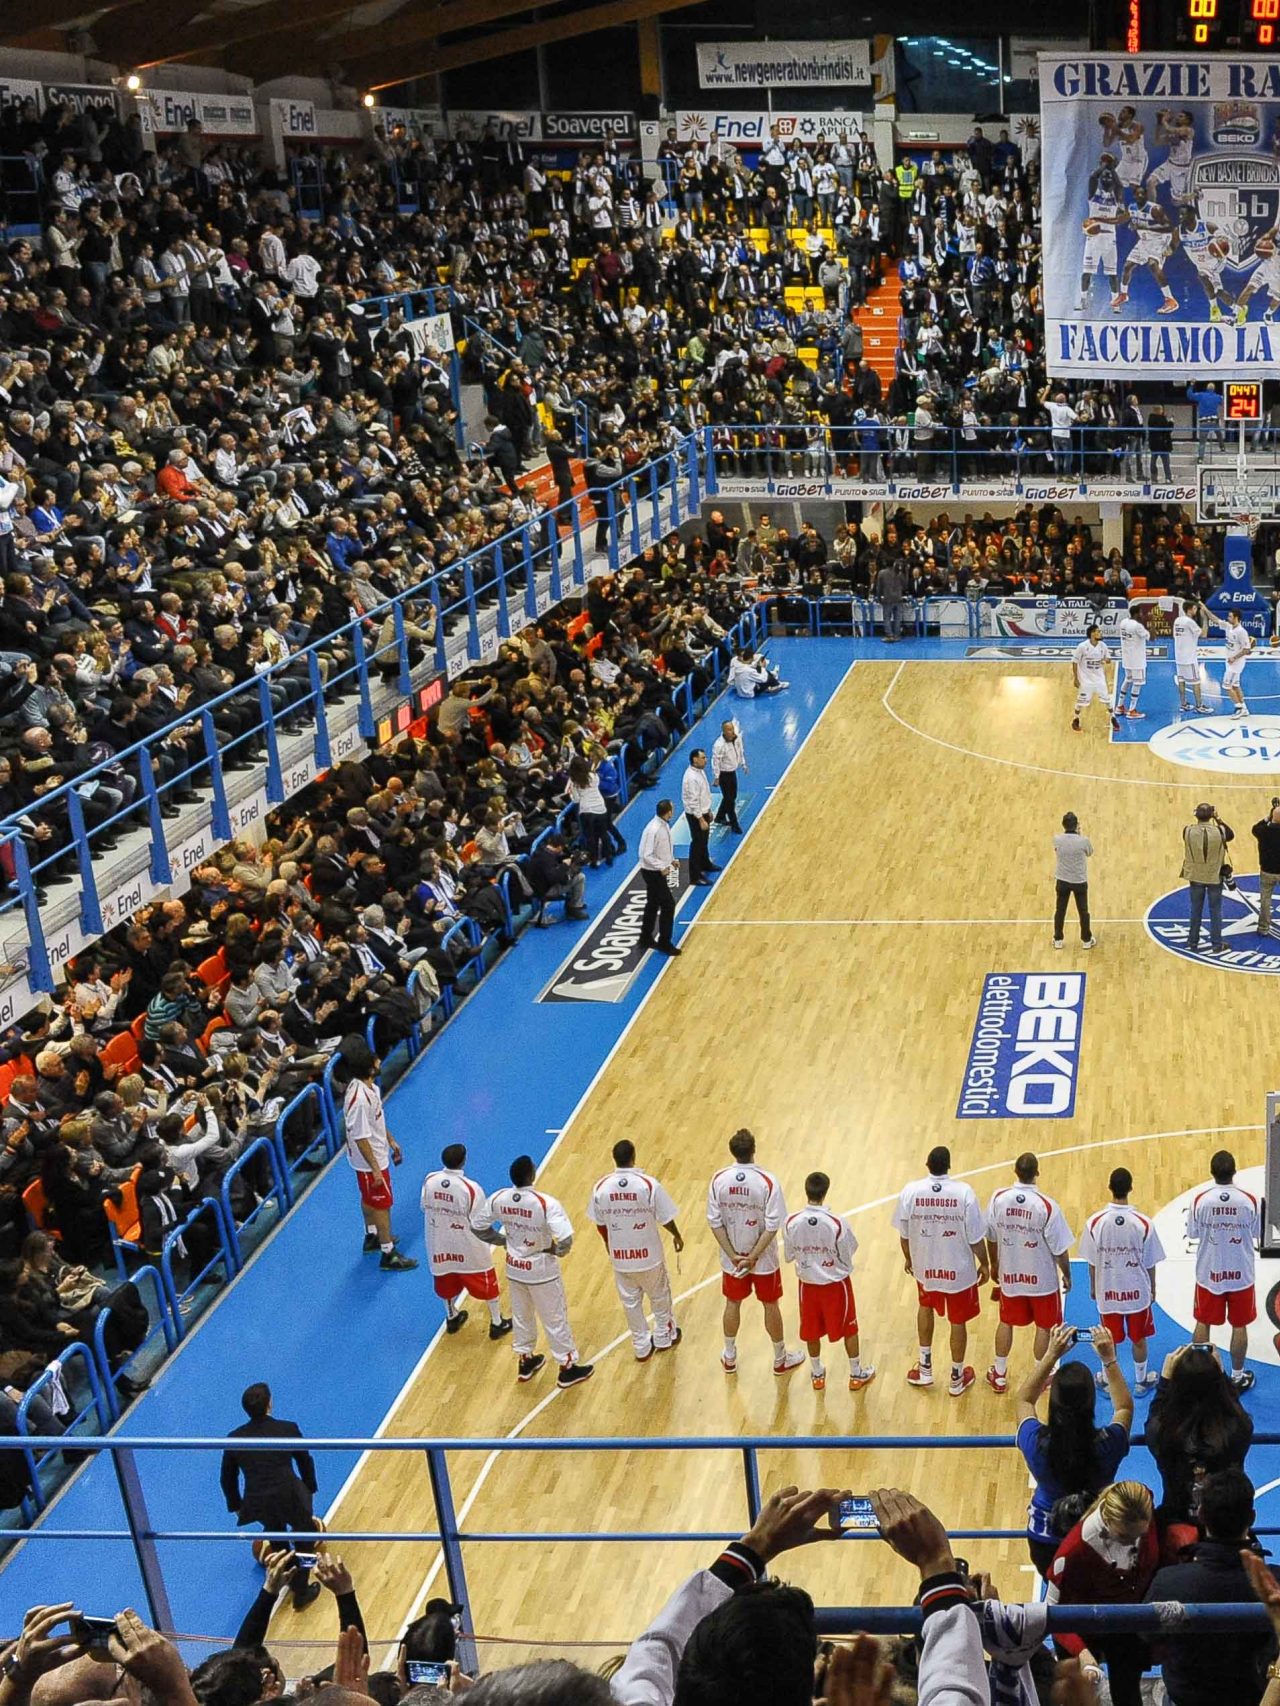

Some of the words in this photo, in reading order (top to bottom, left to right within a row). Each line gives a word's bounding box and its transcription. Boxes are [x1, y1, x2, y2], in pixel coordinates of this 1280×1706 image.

[1053, 63, 1211, 98] GRAZIE
[165, 97, 197, 125] Enel
[289, 105, 315, 132] Enel
[547, 115, 629, 135] Soavegel
[819, 117, 858, 127] BANCA
[714, 115, 763, 137] Enel
[1217, 134, 1255, 144] BEKO
[1200, 168, 1216, 182] NEW
[1217, 165, 1244, 182] BASKET
[1245, 164, 1279, 182] BRINDISI
[1059, 325, 1224, 364] FACCIAMO
[1235, 327, 1275, 364] LA
[1229, 384, 1257, 396] 0447
[1230, 398, 1257, 417] 24
[1232, 592, 1256, 603] Enel
[1084, 612, 1119, 626] Enel
[337, 736, 353, 758] Enel
[292, 764, 309, 791] Enel
[240, 799, 259, 828] Enel
[183, 839, 205, 869] Enel
[117, 883, 142, 918] Enel
[961, 975, 1013, 1117] elettrodomestici
[1005, 975, 1082, 1115] BEKO
[433, 1191, 454, 1203] GREEN
[609, 1192, 638, 1202] BREMER
[728, 1186, 750, 1197] MELLI
[915, 1197, 958, 1208] BOUROUSIS
[1212, 1207, 1238, 1217] FOTSIS
[433, 1252, 465, 1265] MILANO
[613, 1247, 649, 1260] MILANO
[925, 1269, 956, 1281] MILANO
[1003, 1272, 1038, 1285] MILANO
[1209, 1270, 1242, 1283] MILANO
[1104, 1289, 1140, 1302] MILANO
